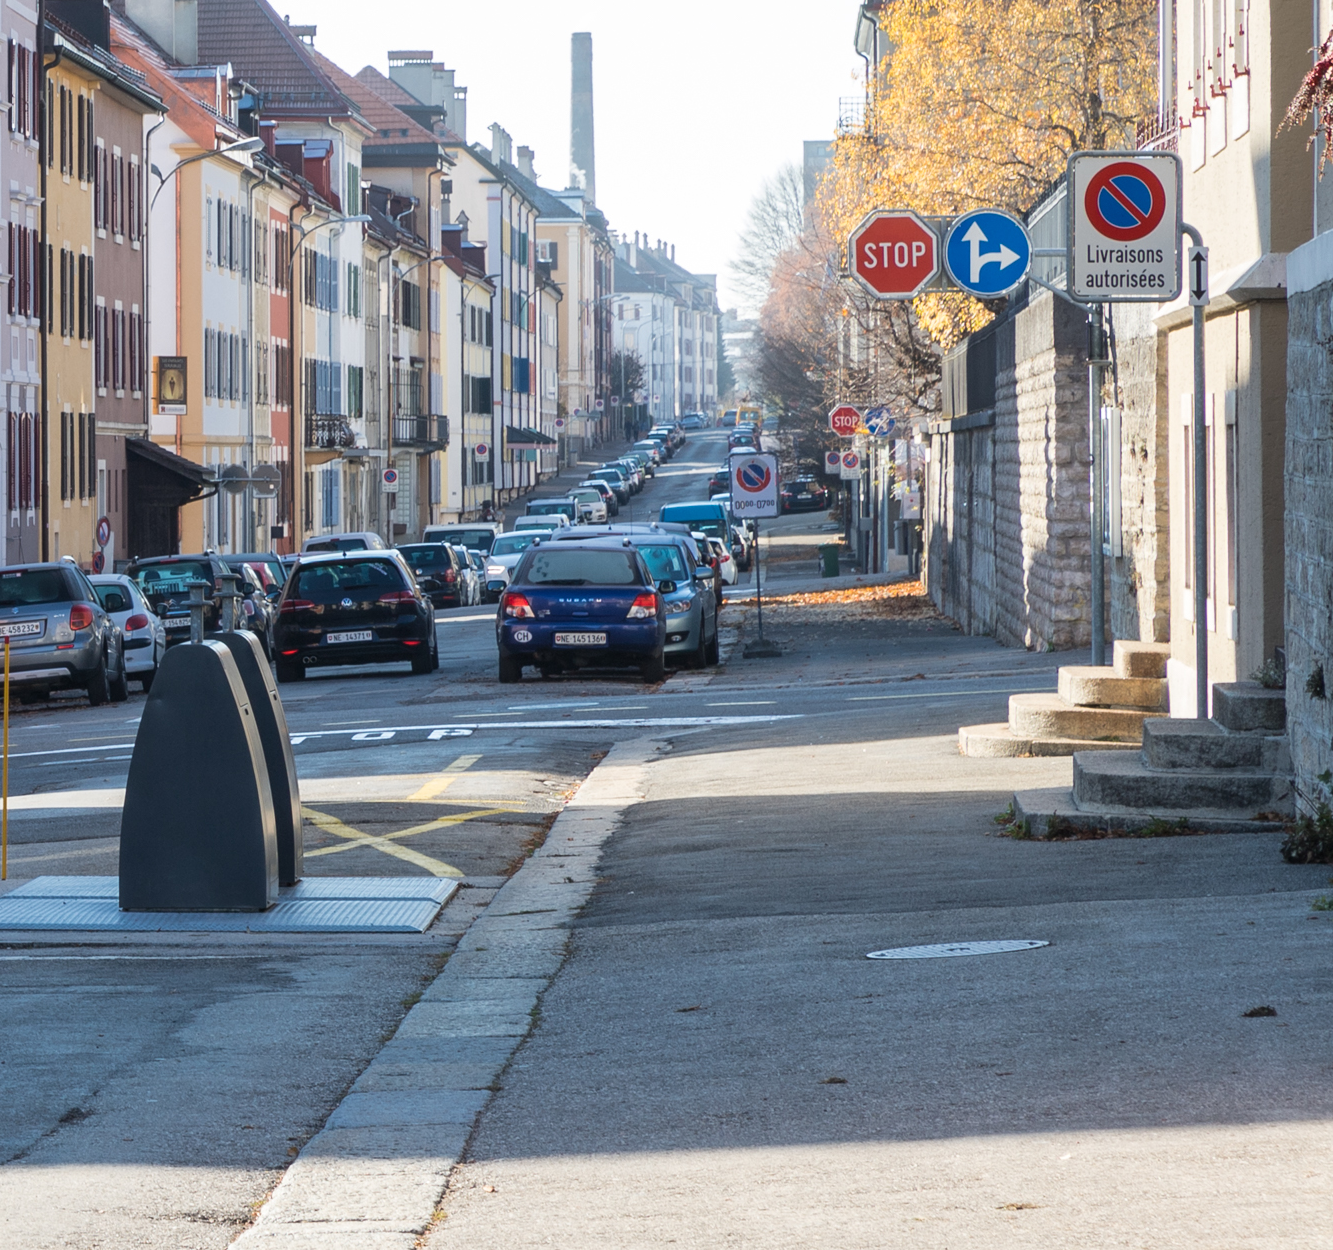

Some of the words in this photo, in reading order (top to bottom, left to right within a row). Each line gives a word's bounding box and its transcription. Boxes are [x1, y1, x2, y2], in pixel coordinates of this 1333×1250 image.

[864, 241, 926, 269] STOP
[1087, 244, 1164, 263] Livraisons
[1086, 269, 1165, 288] autorisées
[834, 415, 858, 427] STOP
[516, 632, 529, 642] CH
